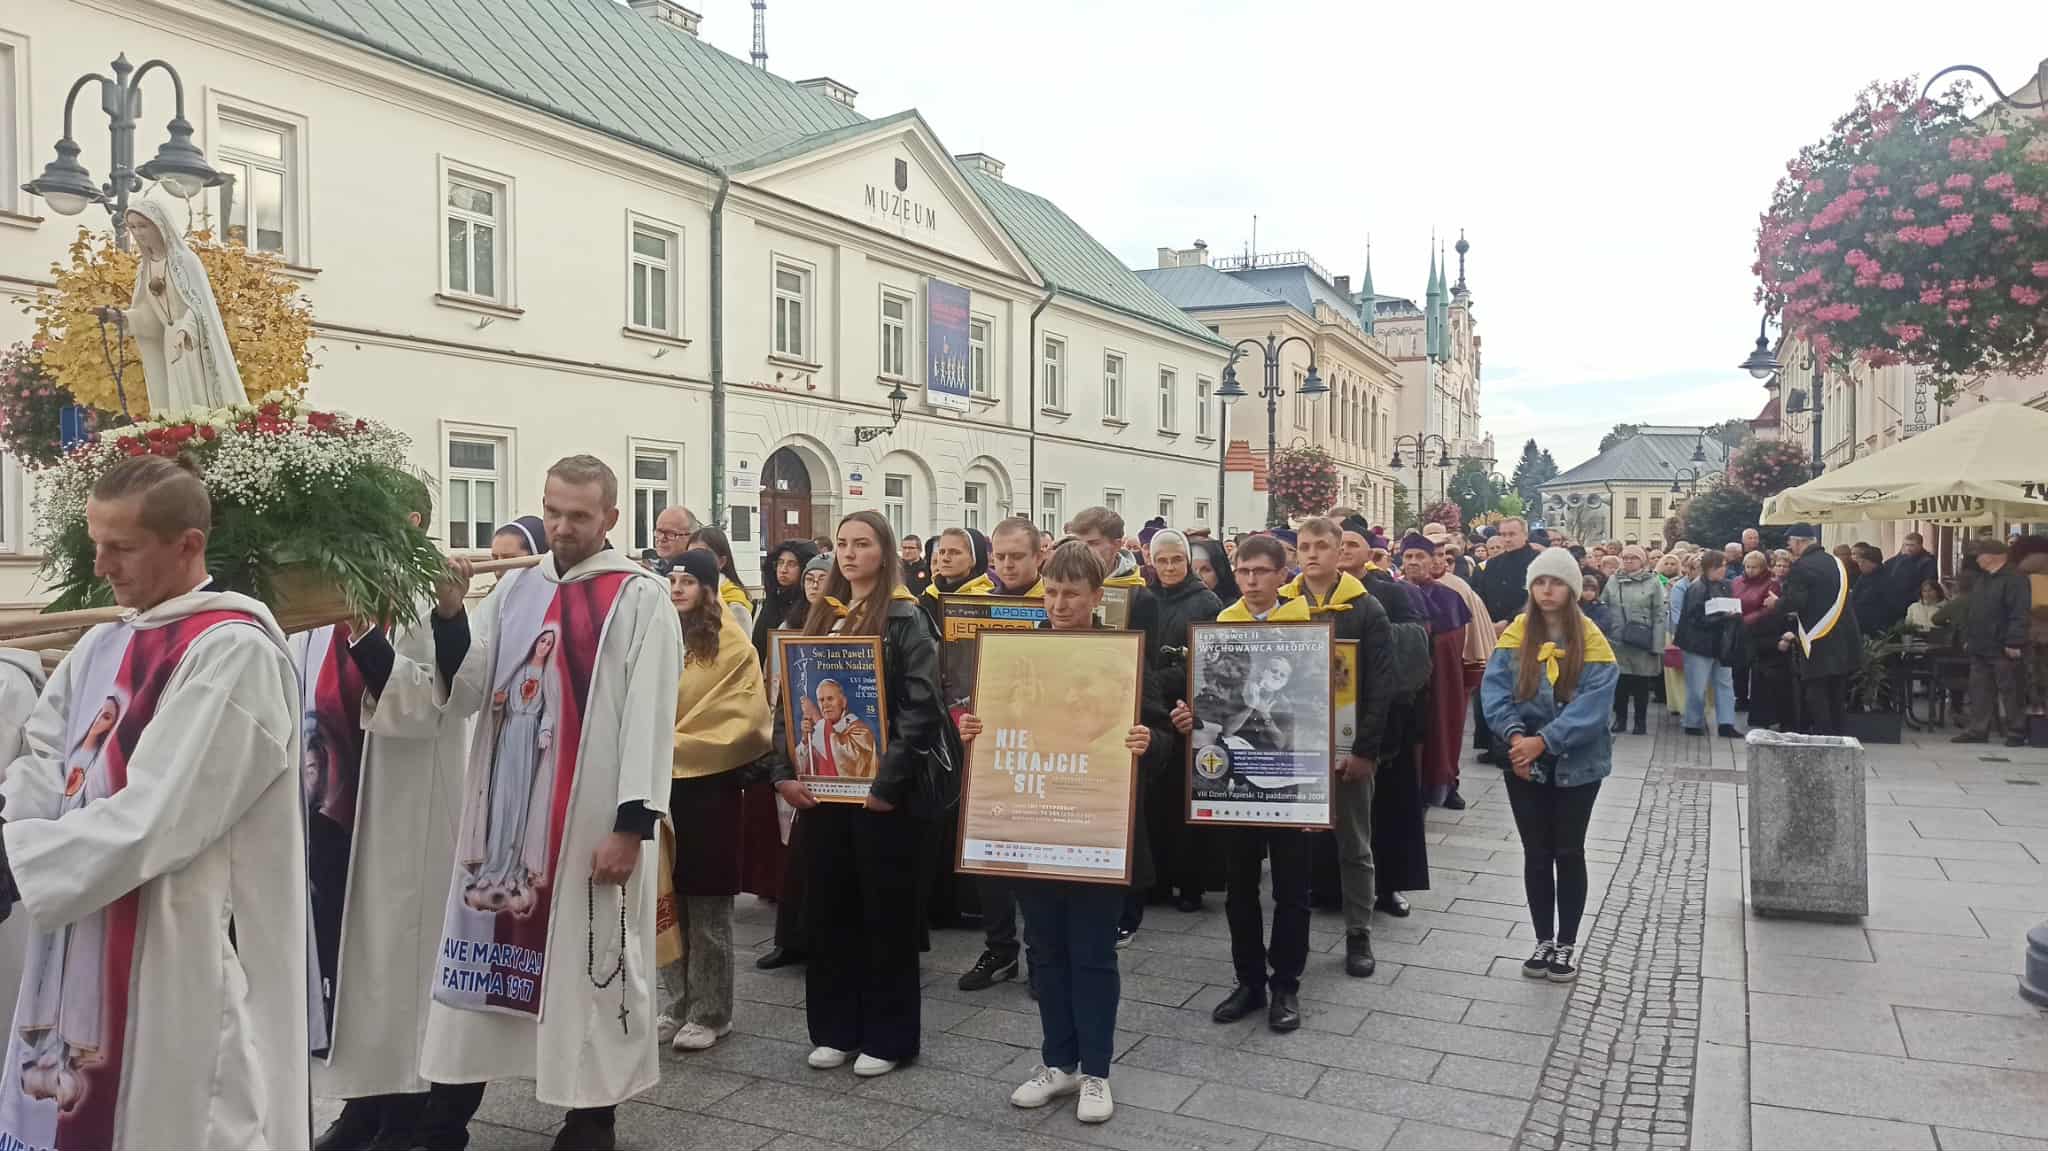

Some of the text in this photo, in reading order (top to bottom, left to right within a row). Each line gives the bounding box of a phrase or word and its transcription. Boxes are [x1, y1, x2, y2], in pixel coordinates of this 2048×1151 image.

[865, 184, 935, 231] MUZEUM
[993, 607, 1048, 618] APOSTO
[827, 648, 841, 659] Jan
[1199, 643, 1273, 652] WYCHOWAWCA
[816, 660, 844, 671] Prorok
[995, 727, 1029, 749] NIE
[993, 751, 1089, 775] LĘKAJCIE
[1014, 773, 1047, 799] SIĘ
[443, 936, 543, 976] AVE MARYJA!
[442, 966, 534, 1002] FATIMA 1917
